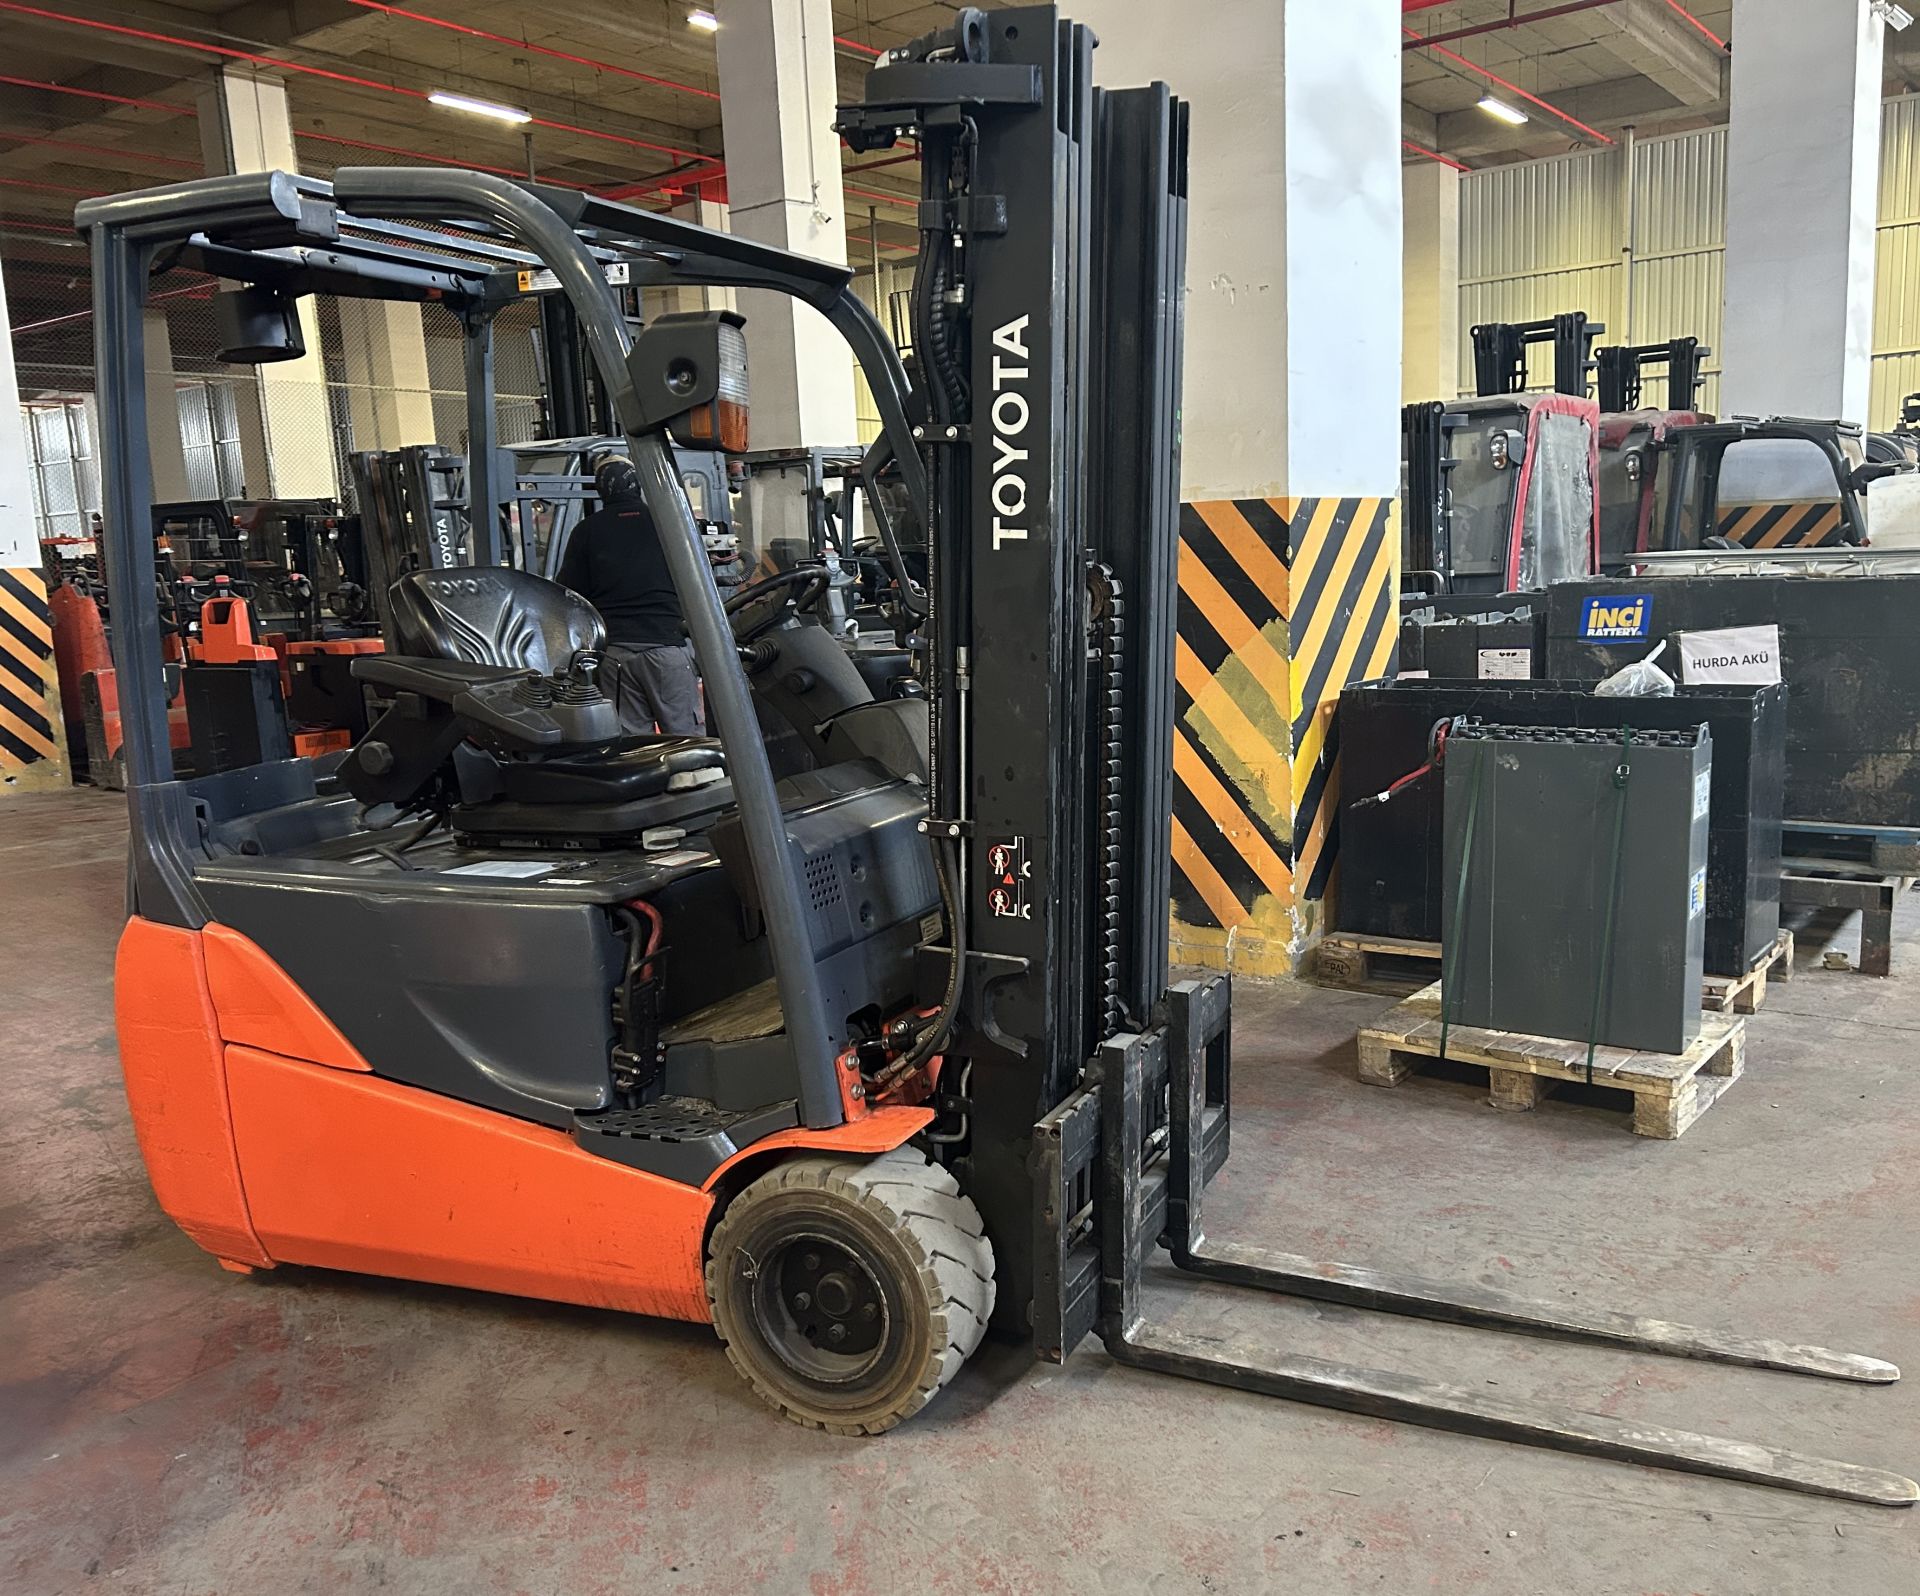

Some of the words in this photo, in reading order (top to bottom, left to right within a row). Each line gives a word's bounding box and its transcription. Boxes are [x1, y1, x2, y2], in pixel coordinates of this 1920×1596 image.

[992, 314, 1029, 550] TOYOTA
[436, 518, 453, 569] TOYOTA
[1587, 627, 1639, 636] BATTERY
[1693, 656, 1738, 669] HURDA
[1742, 651, 1768, 665] AKÜ
